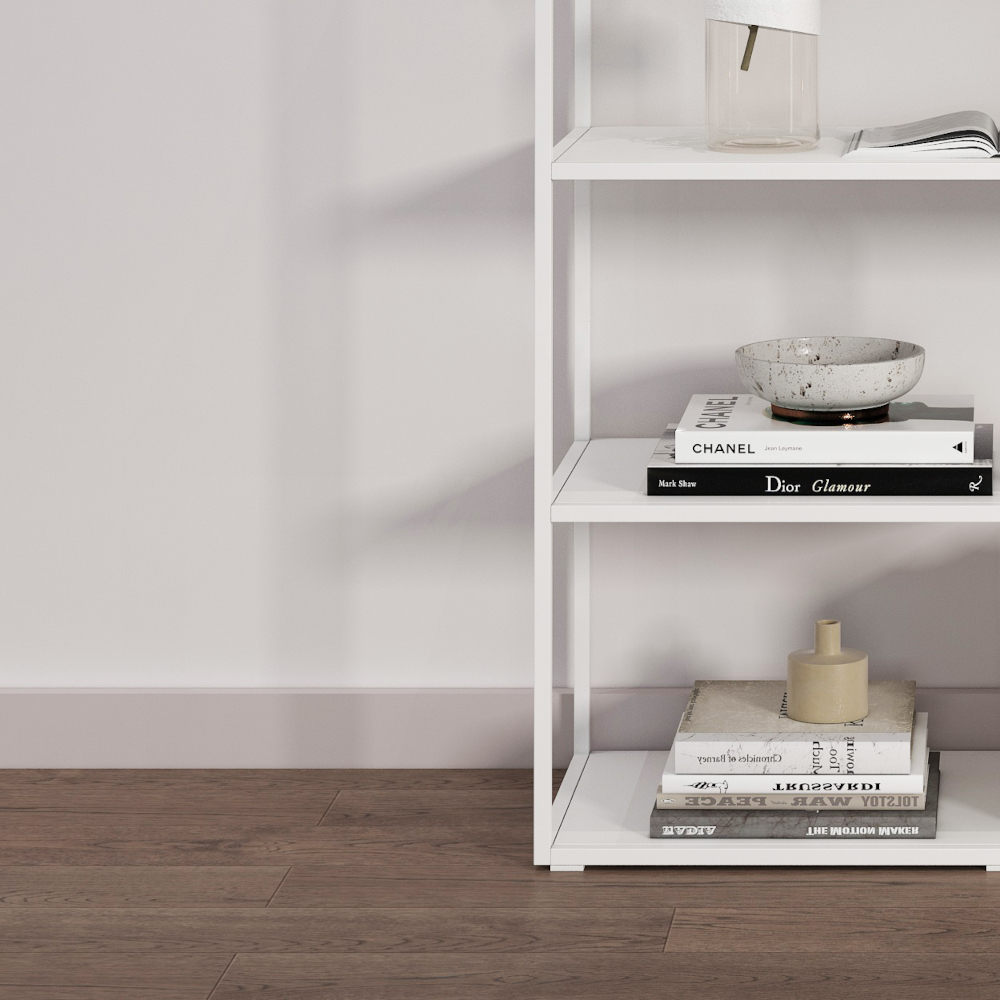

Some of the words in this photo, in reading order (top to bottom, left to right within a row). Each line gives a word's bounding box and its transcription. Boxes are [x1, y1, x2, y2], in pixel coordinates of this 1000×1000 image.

[695, 396, 738, 429] CHANEL
[692, 443, 756, 454] CHANEL
[658, 479, 677, 488] Mark
[678, 479, 697, 488] Shaw
[764, 475, 801, 493] Dior
[811, 478, 872, 493] Glamour
